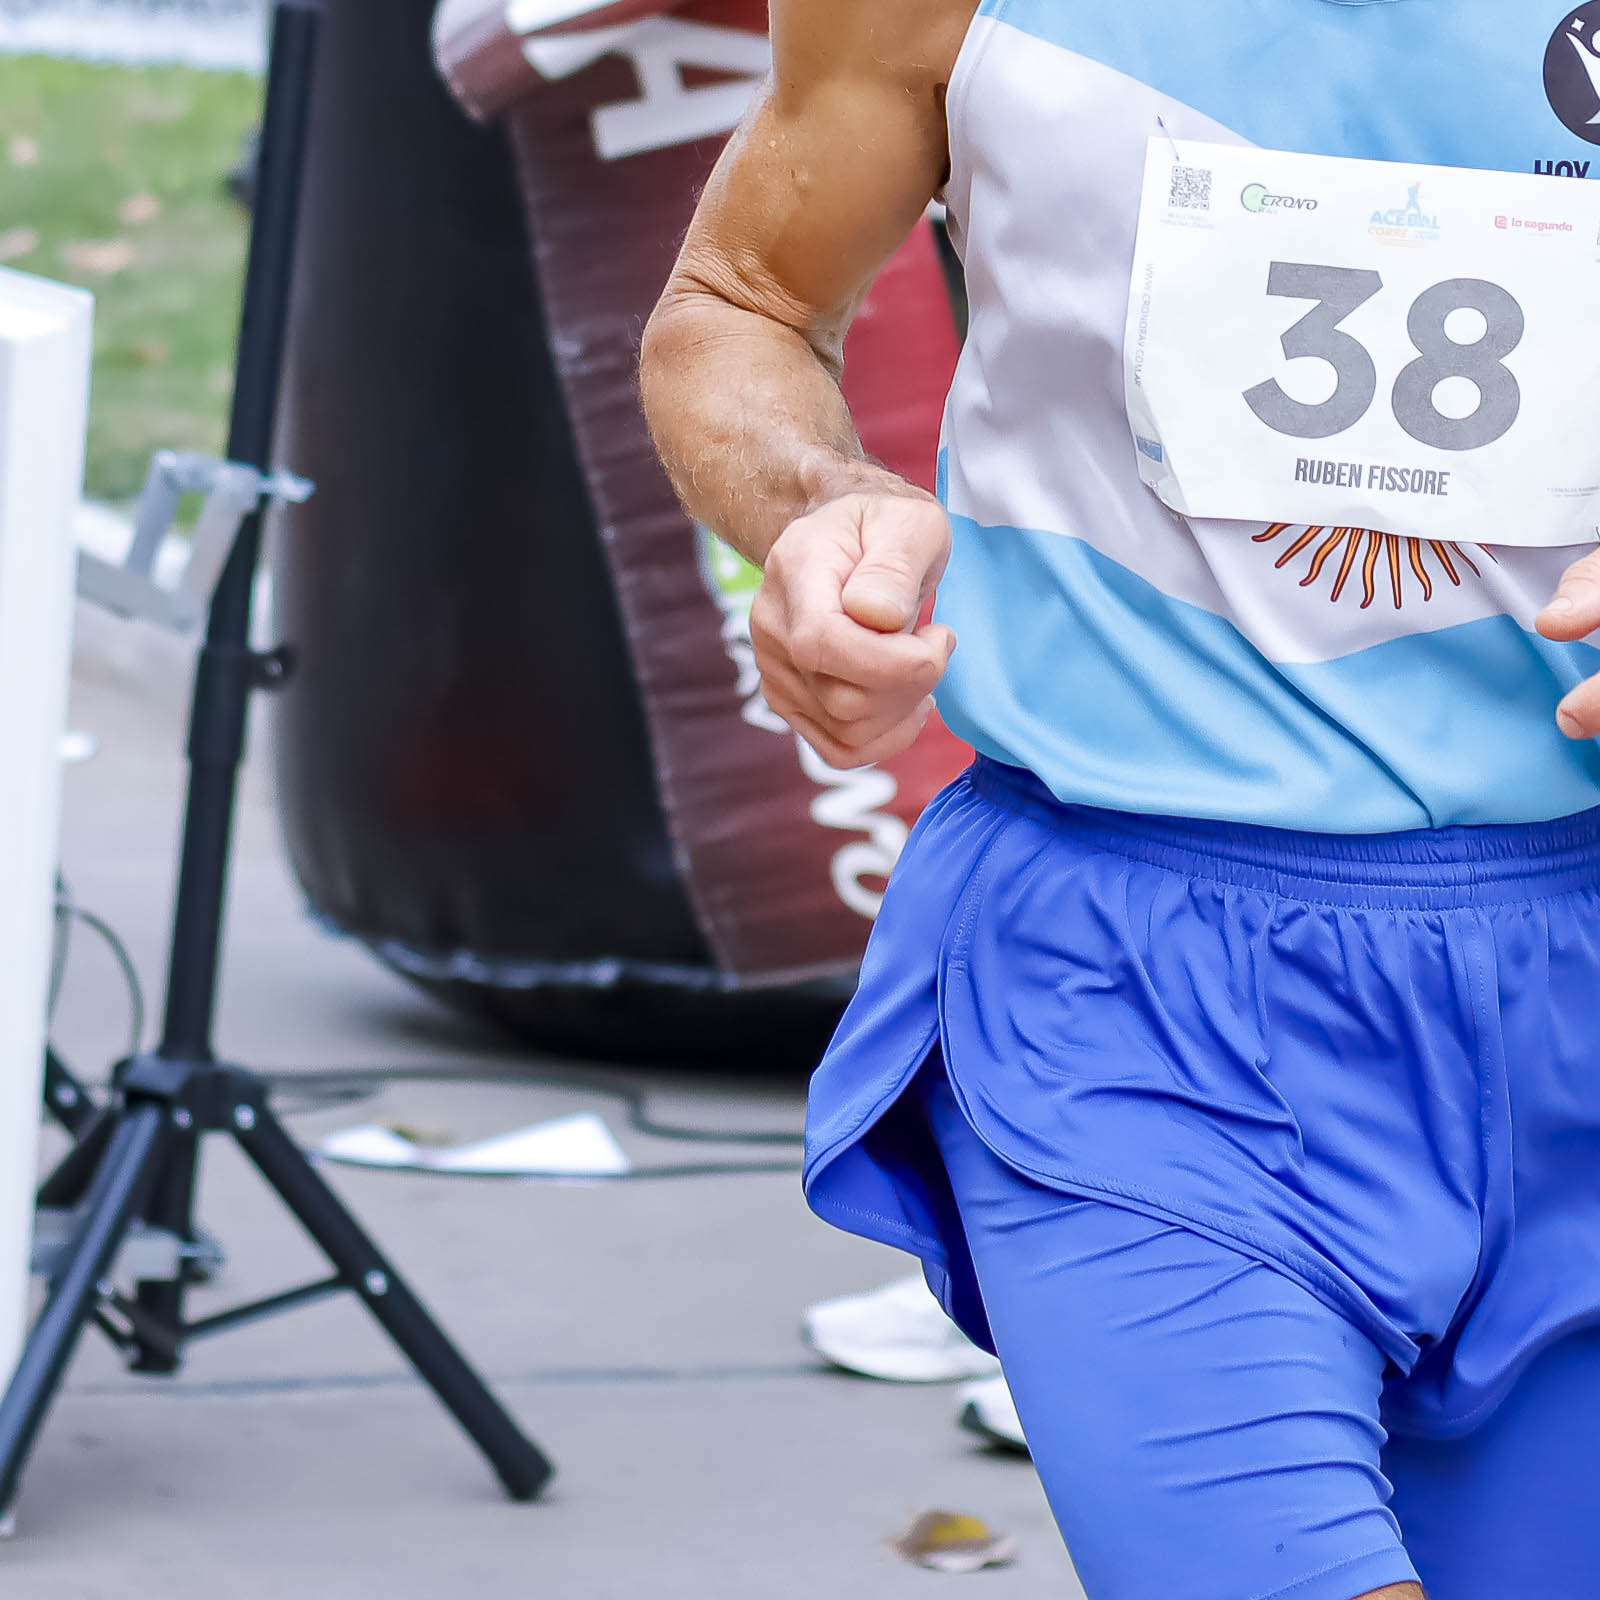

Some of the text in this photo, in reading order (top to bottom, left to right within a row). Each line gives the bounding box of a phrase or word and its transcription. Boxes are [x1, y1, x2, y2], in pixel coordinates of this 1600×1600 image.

[1241, 260, 1525, 451] 38
[1294, 457, 1451, 496] RUBEN FISSORE
